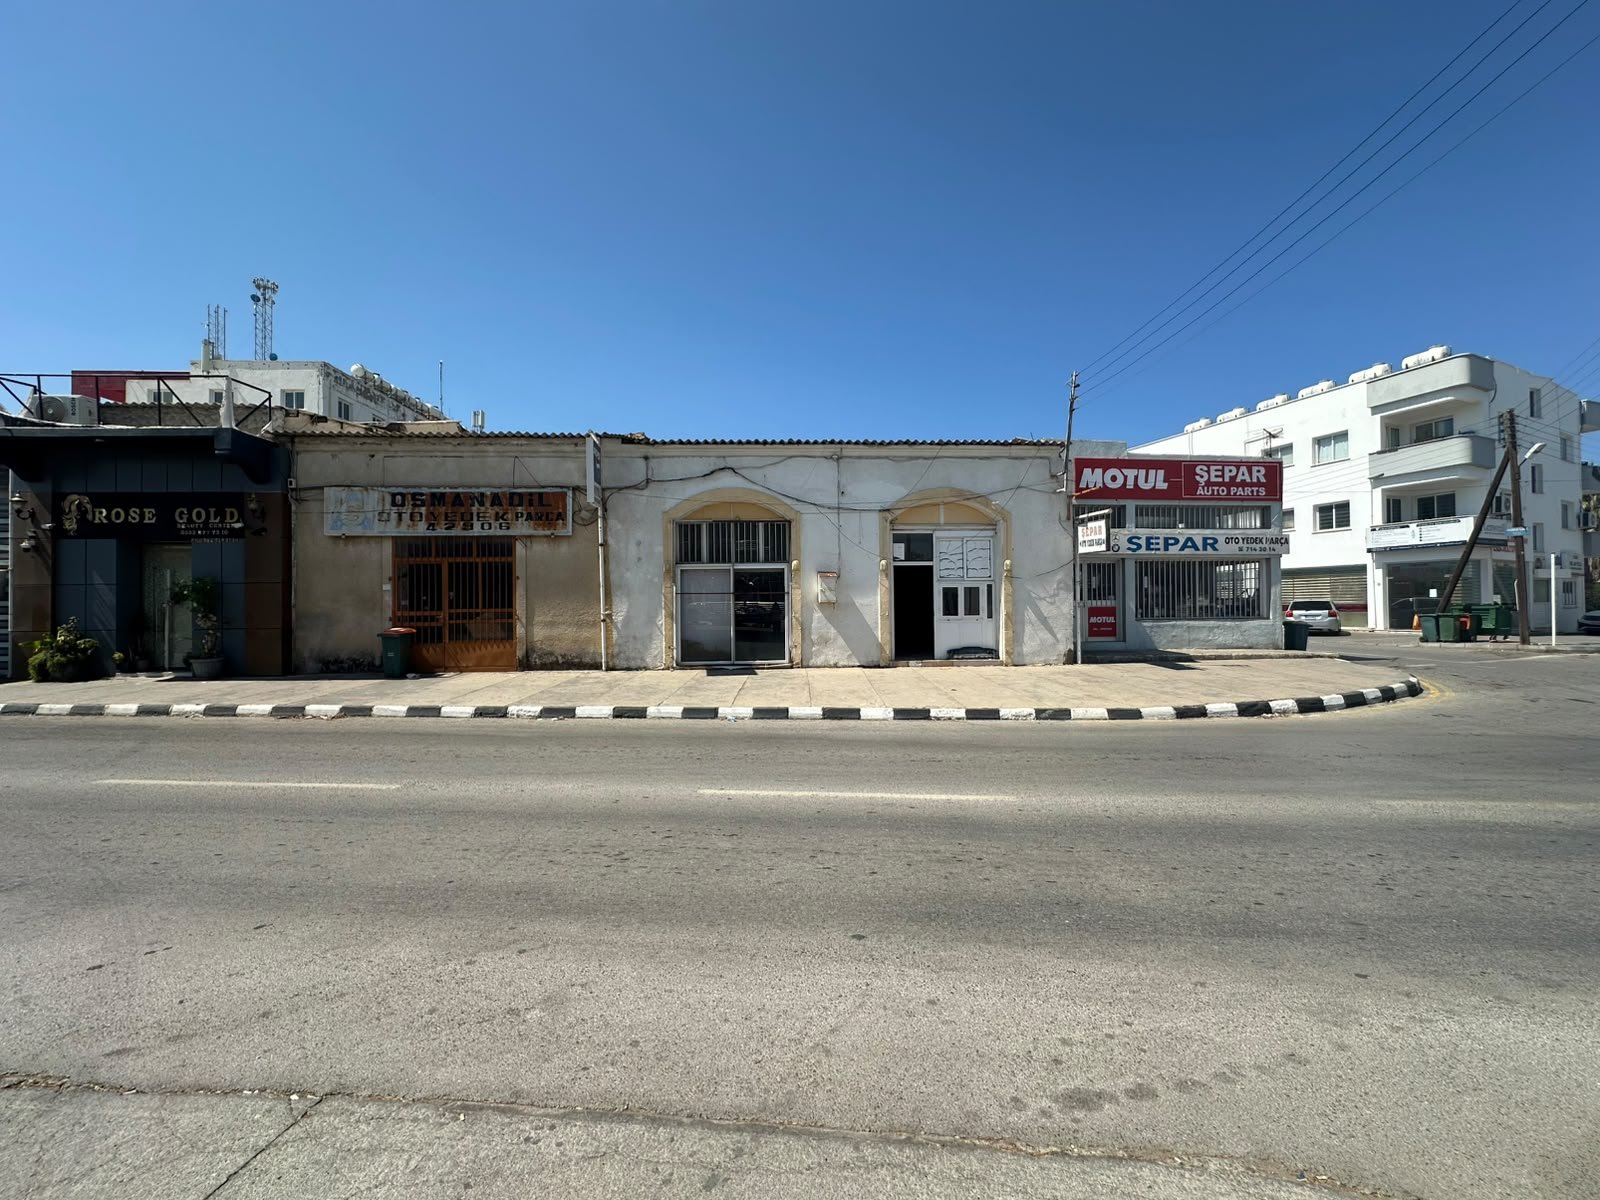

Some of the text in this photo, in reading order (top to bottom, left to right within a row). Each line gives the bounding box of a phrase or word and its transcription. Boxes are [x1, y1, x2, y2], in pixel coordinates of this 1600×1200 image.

[1079, 467, 1168, 490] MOTUL
[1195, 465, 1266, 484] ŞEPAR
[1196, 487, 1266, 496] AUTO PARTS
[93, 508, 239, 523] ROSE GOLD
[1126, 536, 1219, 553] ŞEPAR
[1224, 536, 1240, 545] OTO
[1241, 536, 1264, 545] YEDEK
